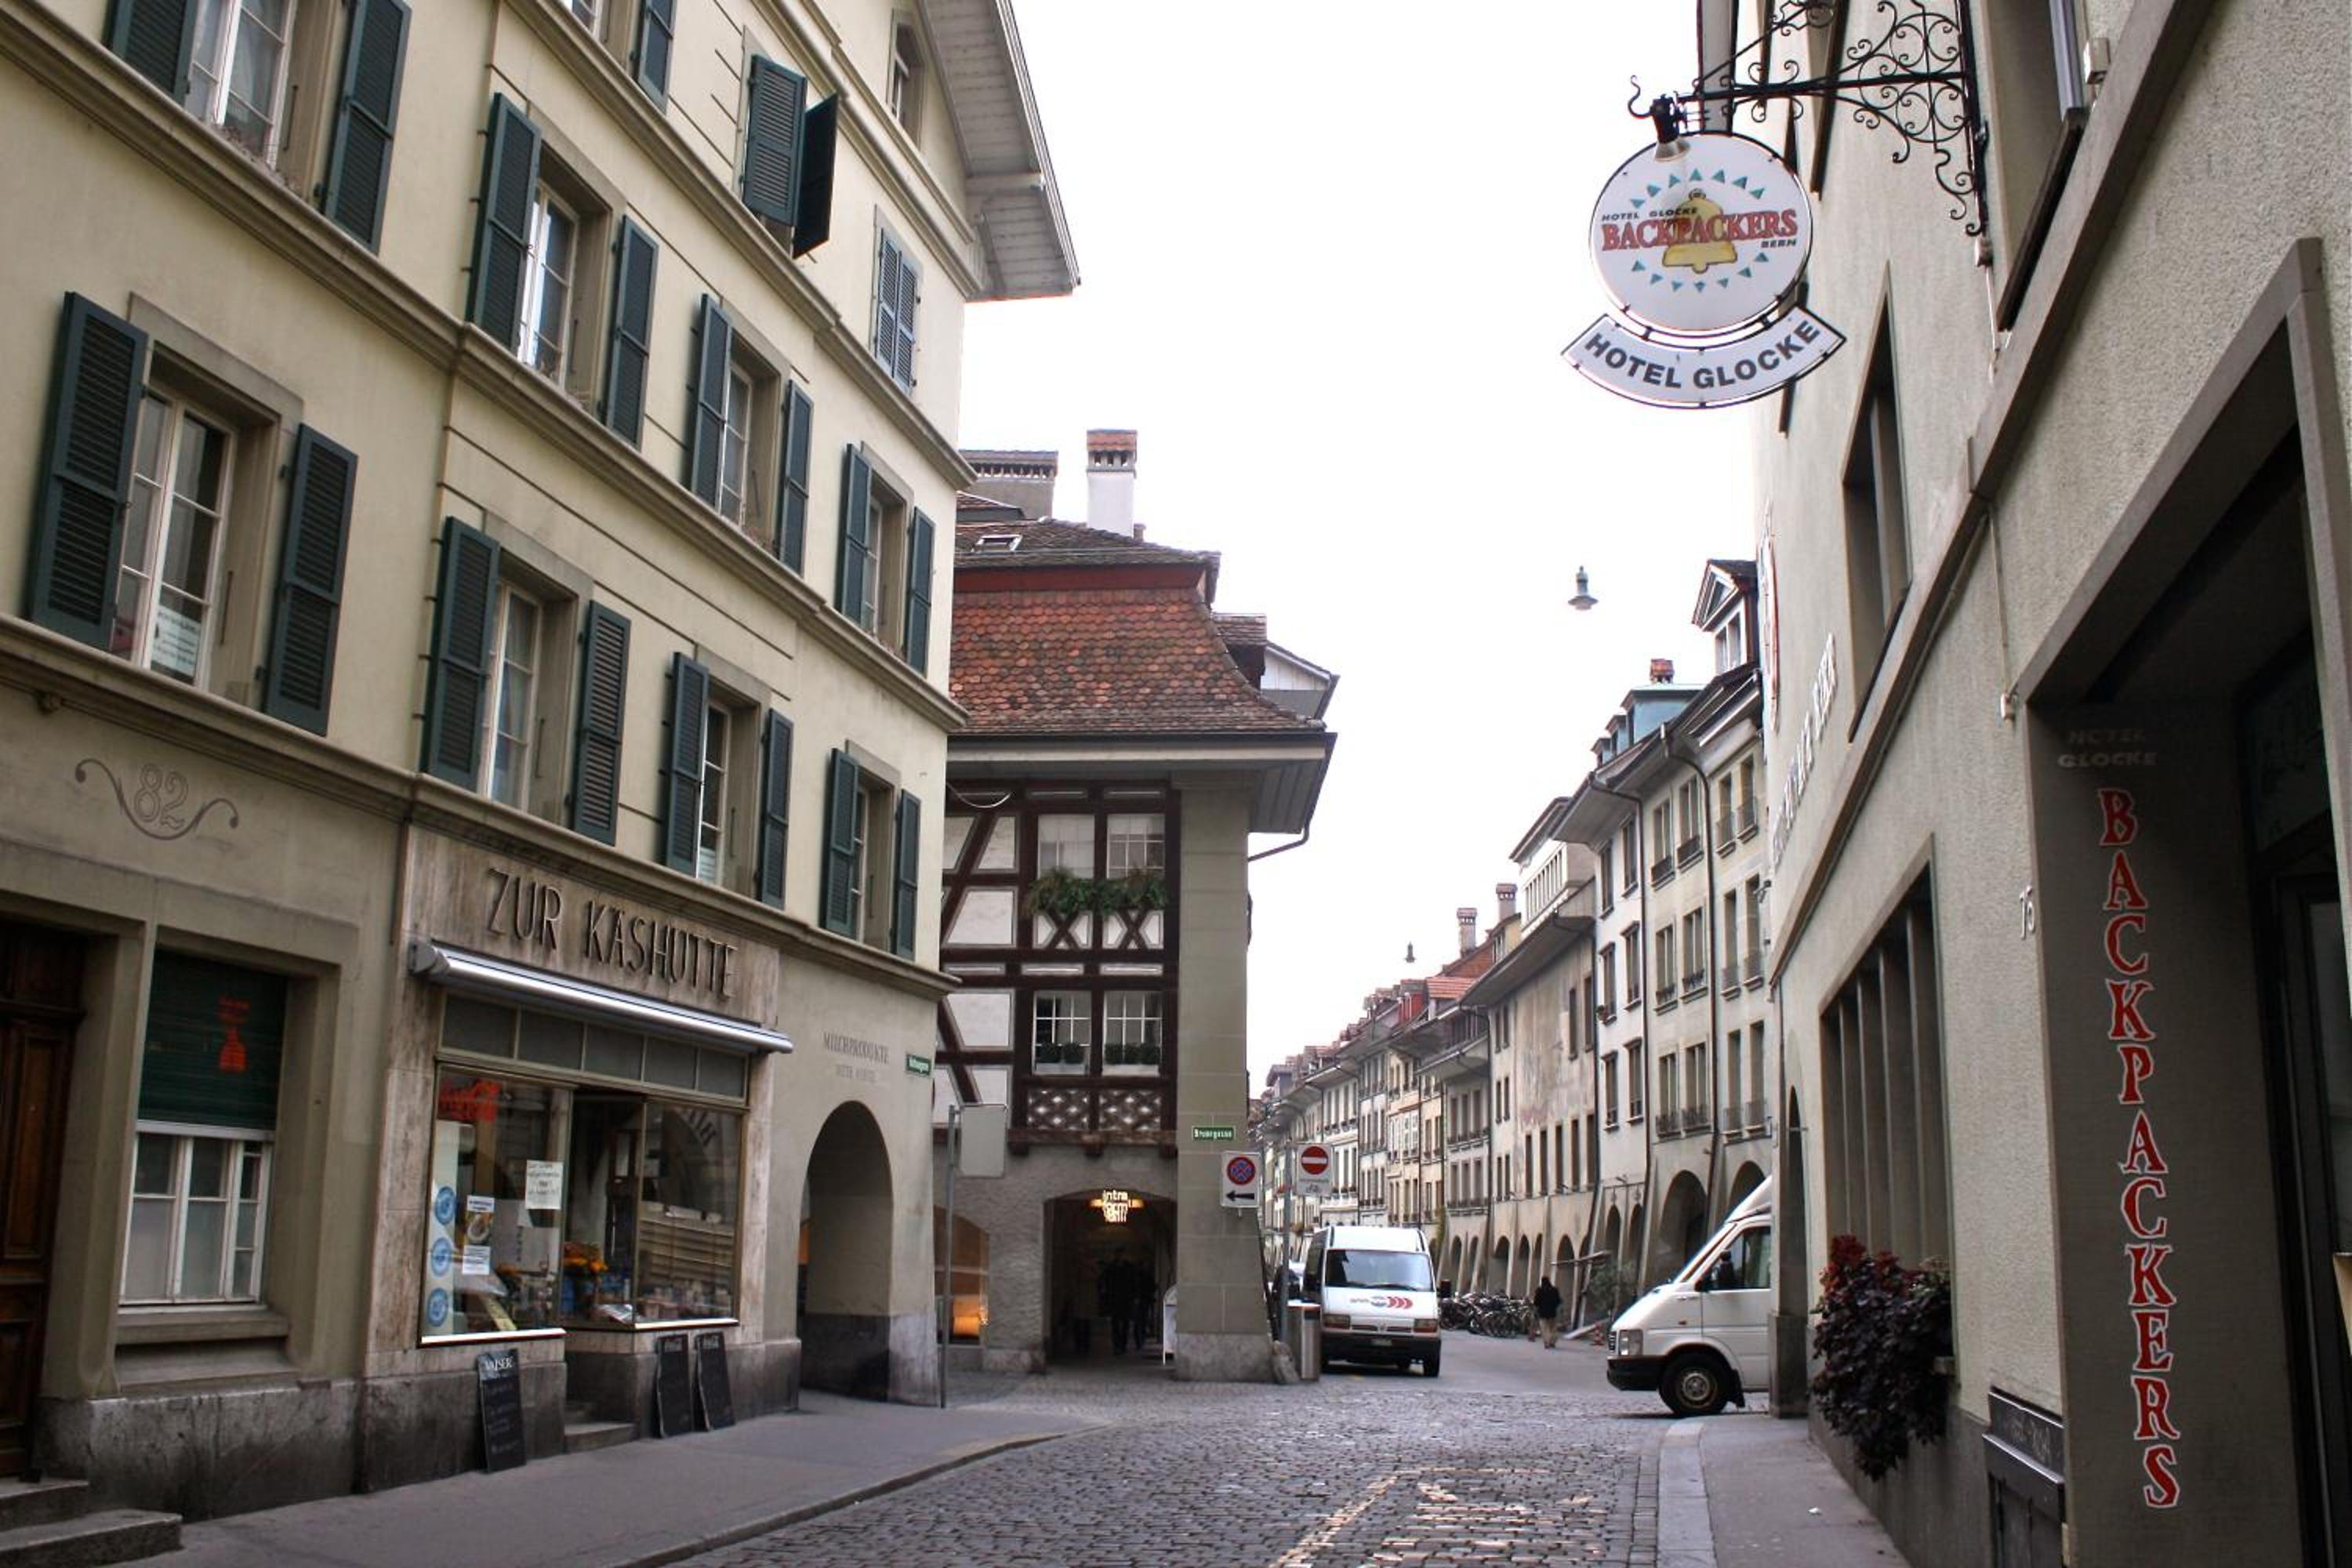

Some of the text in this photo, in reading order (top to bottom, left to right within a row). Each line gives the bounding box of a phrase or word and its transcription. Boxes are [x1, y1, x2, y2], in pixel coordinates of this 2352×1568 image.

[1601, 209, 1799, 252] BACKPACKERS
[1602, 206, 1698, 222] HOTEL GLOCKE
[1760, 238, 1798, 249] BERN
[1584, 319, 1821, 389] HOTEL GLOCKE
[134, 762, 189, 829] 82
[488, 866, 564, 951] ZUR
[2097, 788, 2182, 1509] BACKPACKERS
